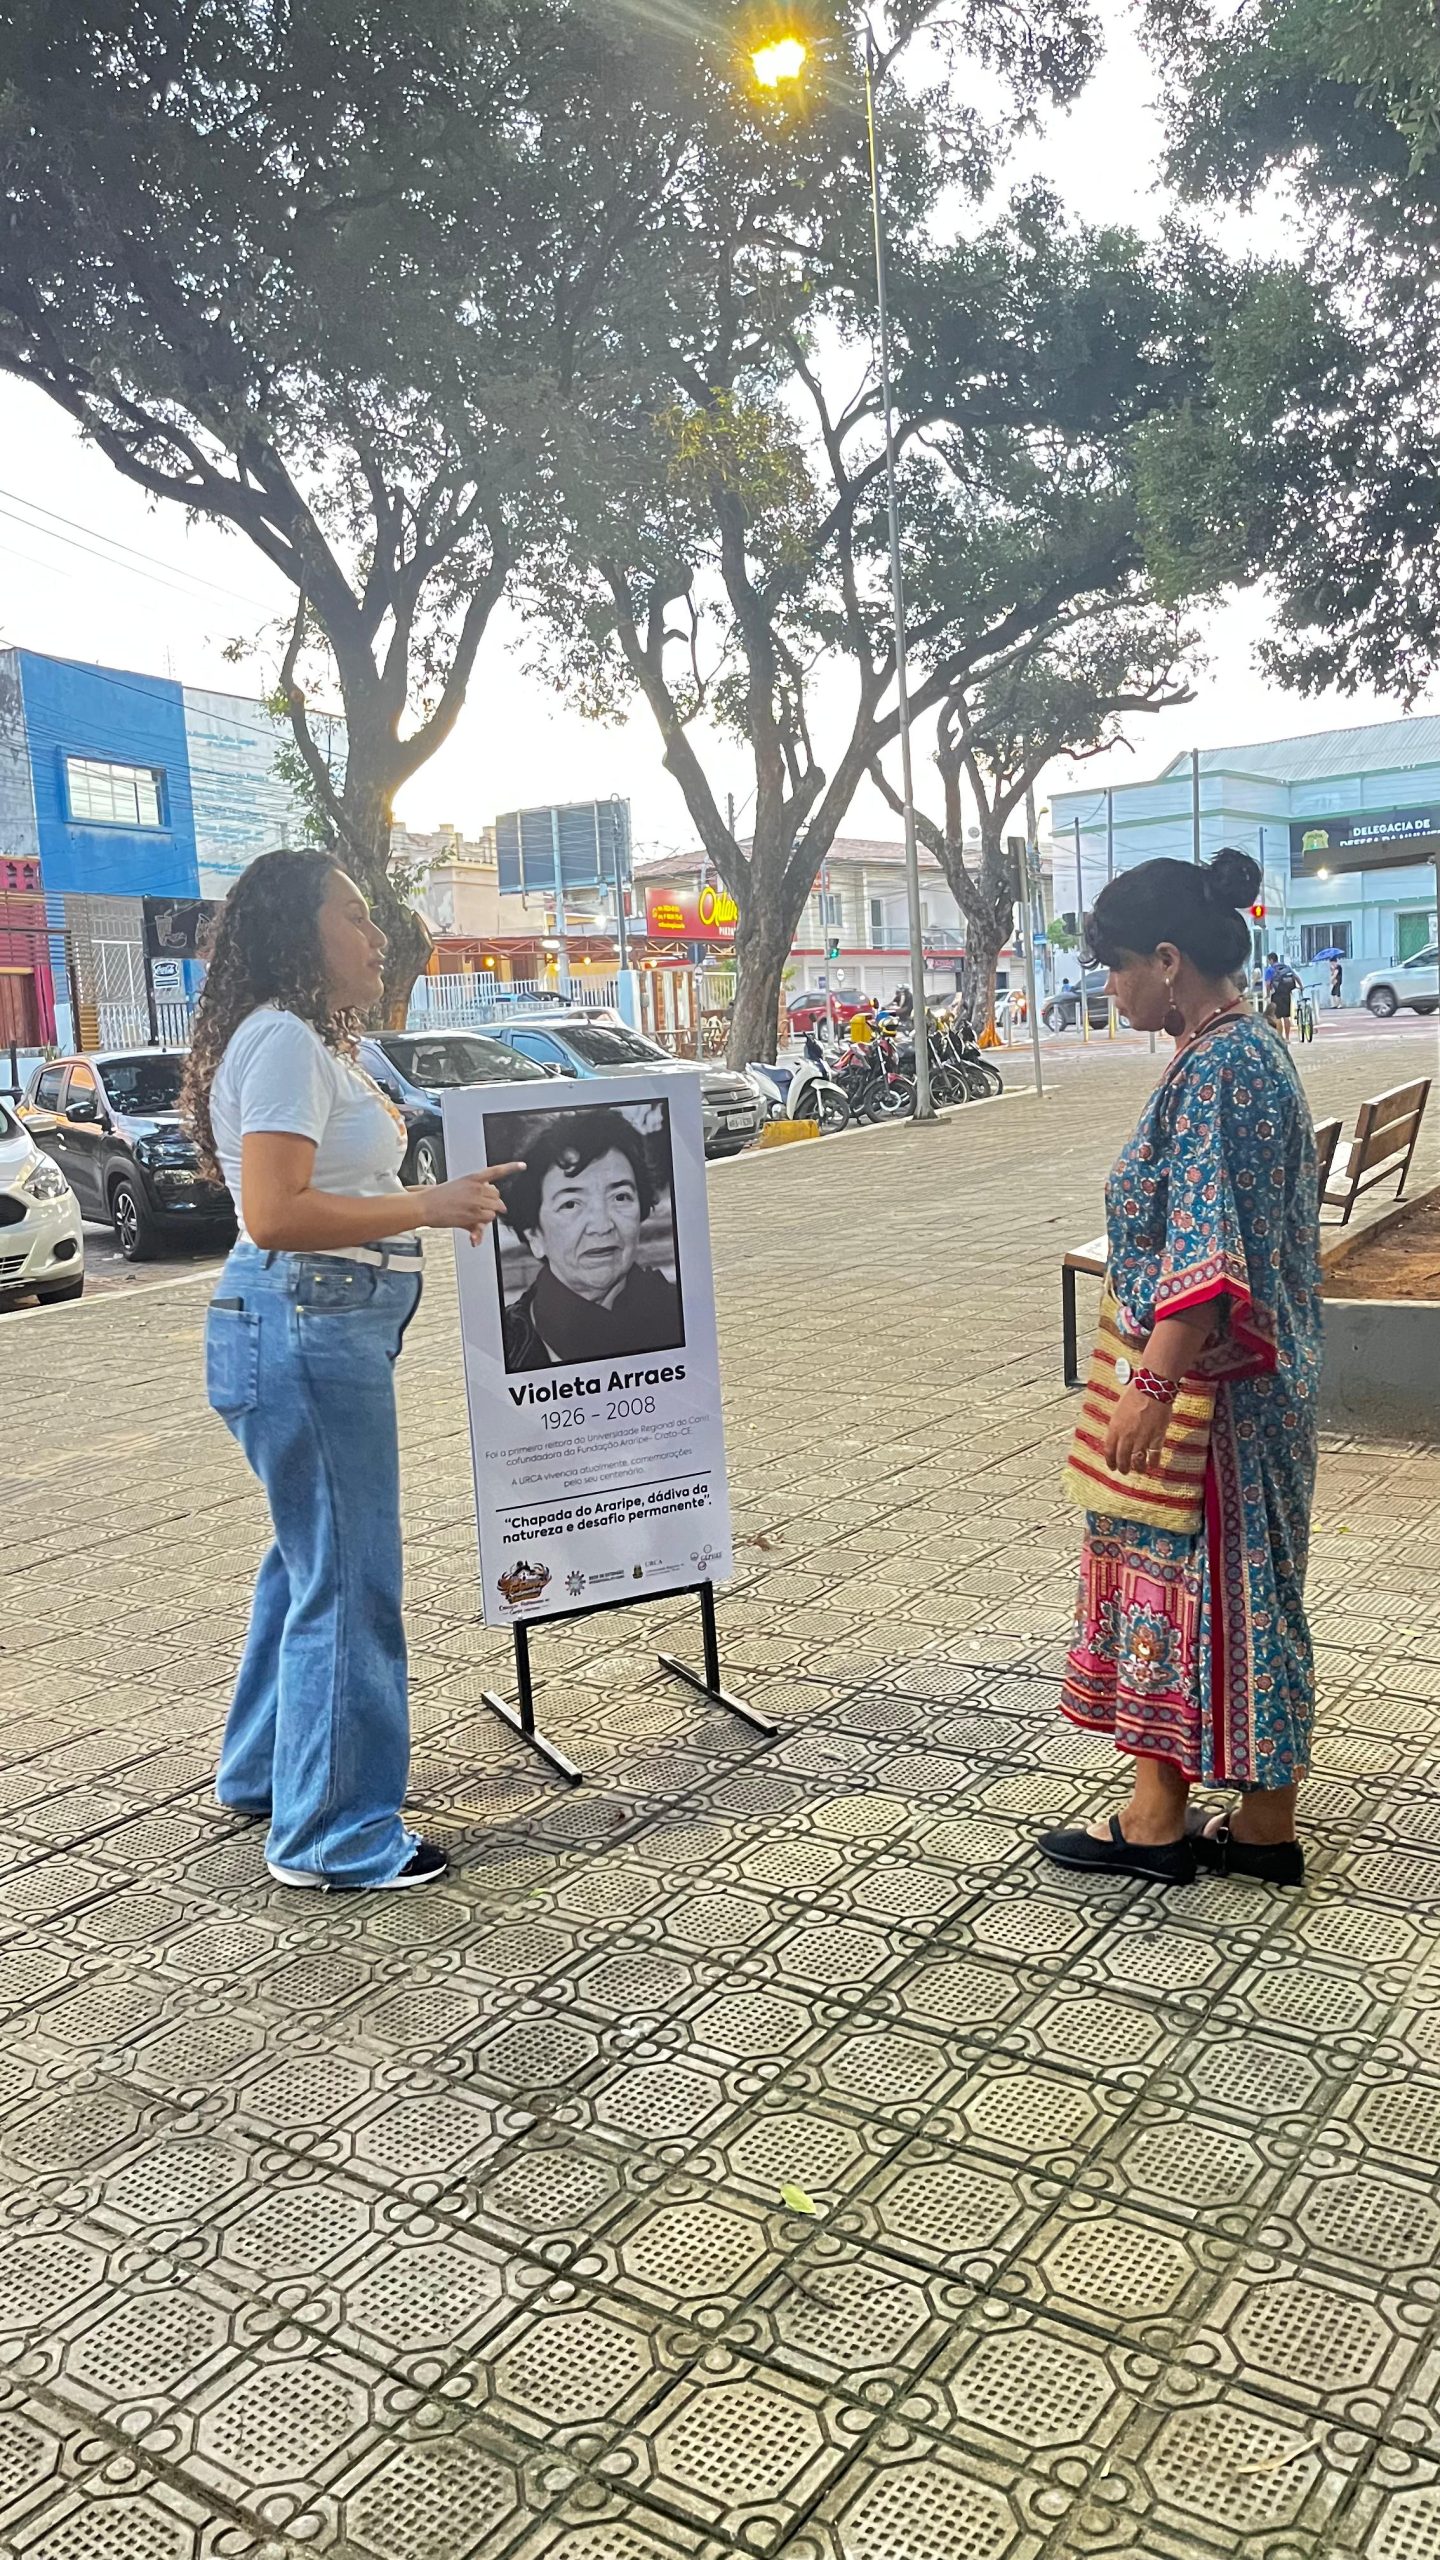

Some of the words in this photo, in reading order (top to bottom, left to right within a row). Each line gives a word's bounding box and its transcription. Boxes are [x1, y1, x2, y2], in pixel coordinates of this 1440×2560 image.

[1353, 820, 1413, 836] DELEGACIA
[1415, 819, 1431, 829] DE
[508, 1376, 601, 1406] Violeta
[607, 1365, 686, 1391] Arraes
[541, 1407, 585, 1430] 1926
[606, 1396, 656, 1420] 2008
[485, 1450, 499, 1459] Foi
[508, 1444, 543, 1456] primeira
[545, 1438, 573, 1449] reitora
[587, 1427, 639, 1442] Universidade
[641, 1420, 675, 1433] Regional
[676, 1418, 687, 1427] do
[506, 1450, 562, 1466] cofundadora
[564, 1448, 575, 1456] da
[577, 1441, 619, 1454] Fundação
[511, 1478, 517, 1486] A
[519, 1474, 543, 1485] URCA
[544, 1468, 578, 1481] vivencia
[630, 1448, 693, 1464] comemorações
[563, 1475, 582, 1488] pelo
[584, 1475, 598, 1485] seu
[575, 1505, 592, 1517] do
[594, 1496, 645, 1515] Araripe,
[648, 1486, 690, 1504] dádiva
[692, 1483, 708, 1496] da
[503, 1524, 563, 1544] natureza
[566, 1523, 574, 1533] e
[577, 1511, 625, 1531] desafio
